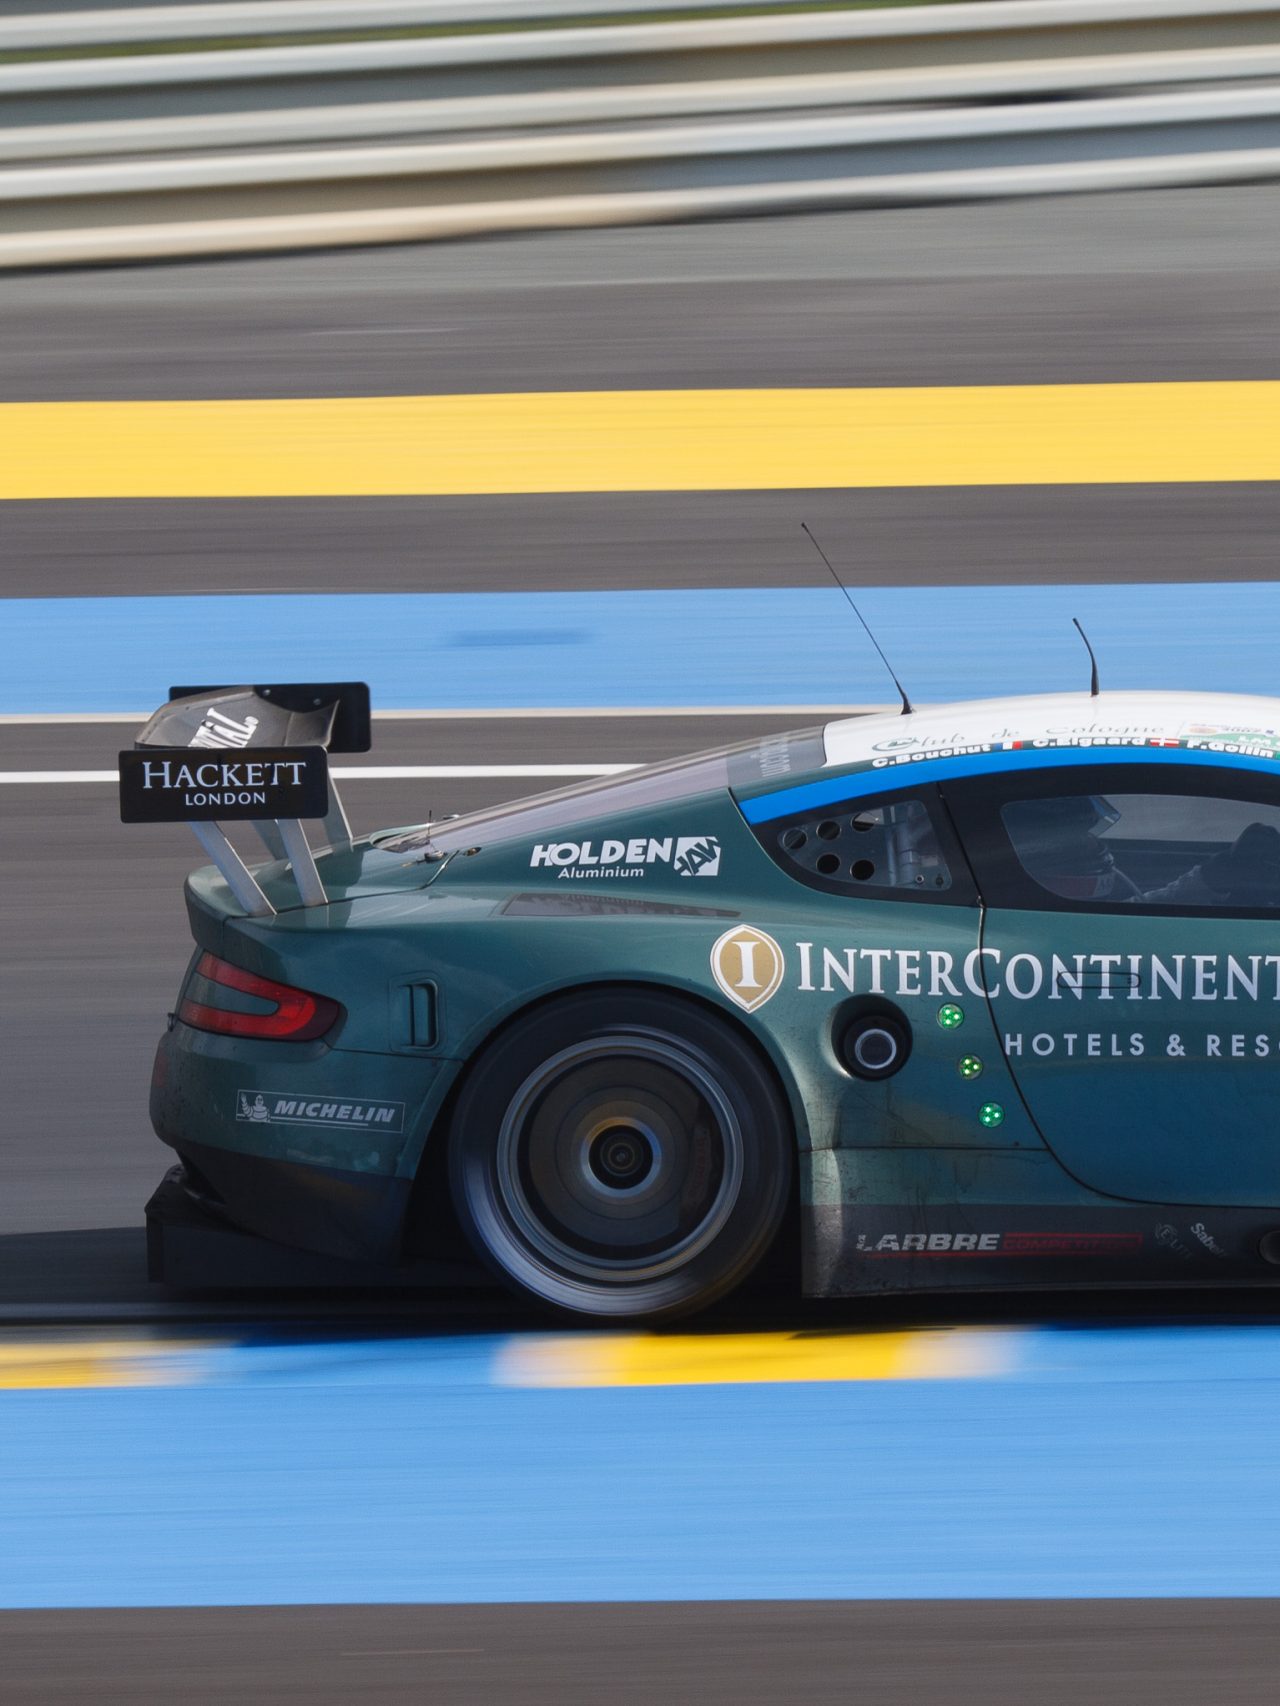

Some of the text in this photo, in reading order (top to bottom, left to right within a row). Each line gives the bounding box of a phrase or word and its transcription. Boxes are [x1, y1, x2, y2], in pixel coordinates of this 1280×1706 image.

[872, 744, 991, 768] C.Bouchut
[142, 761, 306, 789] HACKETT
[185, 792, 266, 806] LONDON
[529, 837, 673, 867] HOLDEN
[557, 866, 644, 880] Aluminium
[1005, 1033, 1145, 1056] HOTELS
[1166, 1034, 1186, 1056] &
[274, 1099, 396, 1123] MICHELIN
[856, 1233, 1001, 1252] LARBRE
